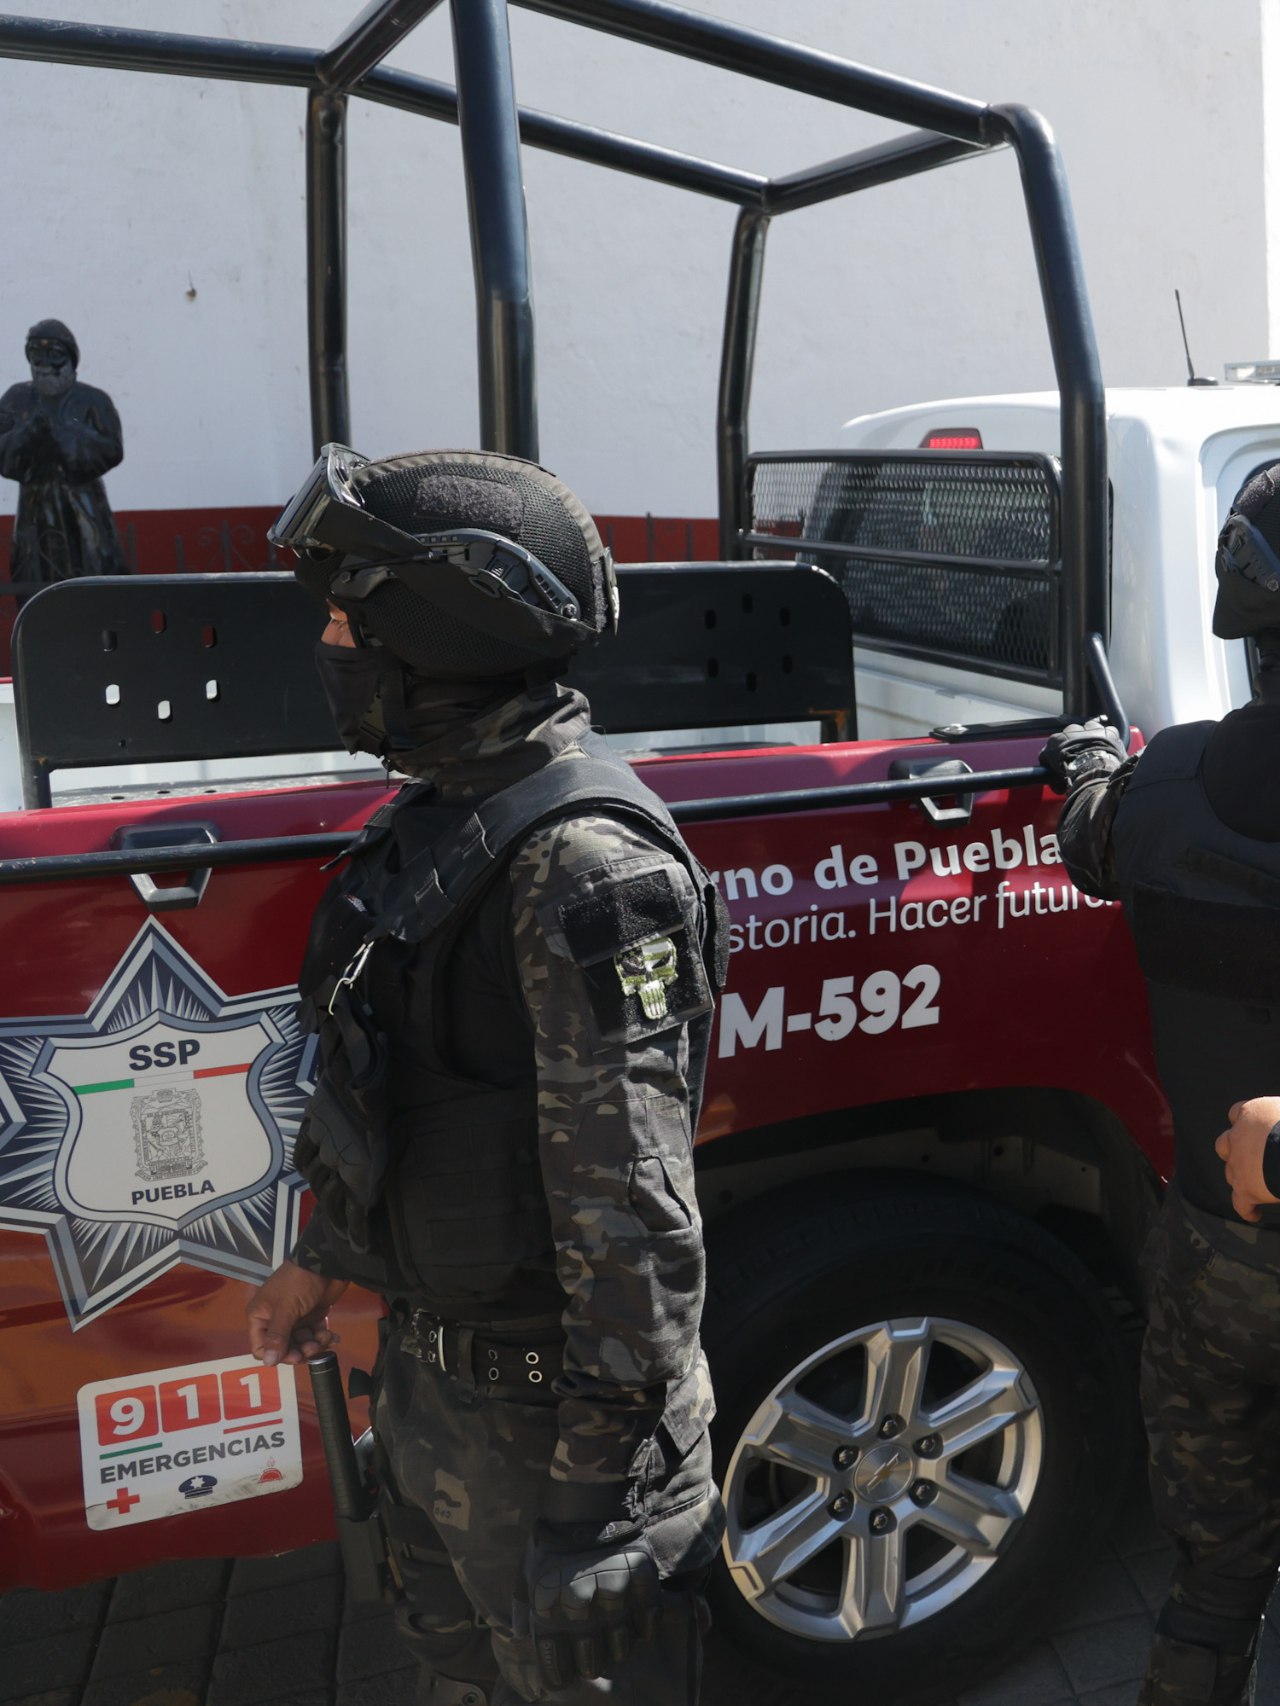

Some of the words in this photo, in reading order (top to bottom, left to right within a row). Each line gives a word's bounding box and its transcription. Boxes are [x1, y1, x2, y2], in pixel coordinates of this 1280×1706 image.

[814, 844, 879, 890] de
[894, 824, 1063, 880] Puebla
[869, 894, 987, 935] Hacer
[718, 964, 941, 1059] M-592
[128, 1038, 200, 1071] SSP
[131, 1179, 215, 1205] PUEBLA
[110, 1373, 262, 1436] 911
[100, 1431, 285, 1484] EMERGENCIAS
